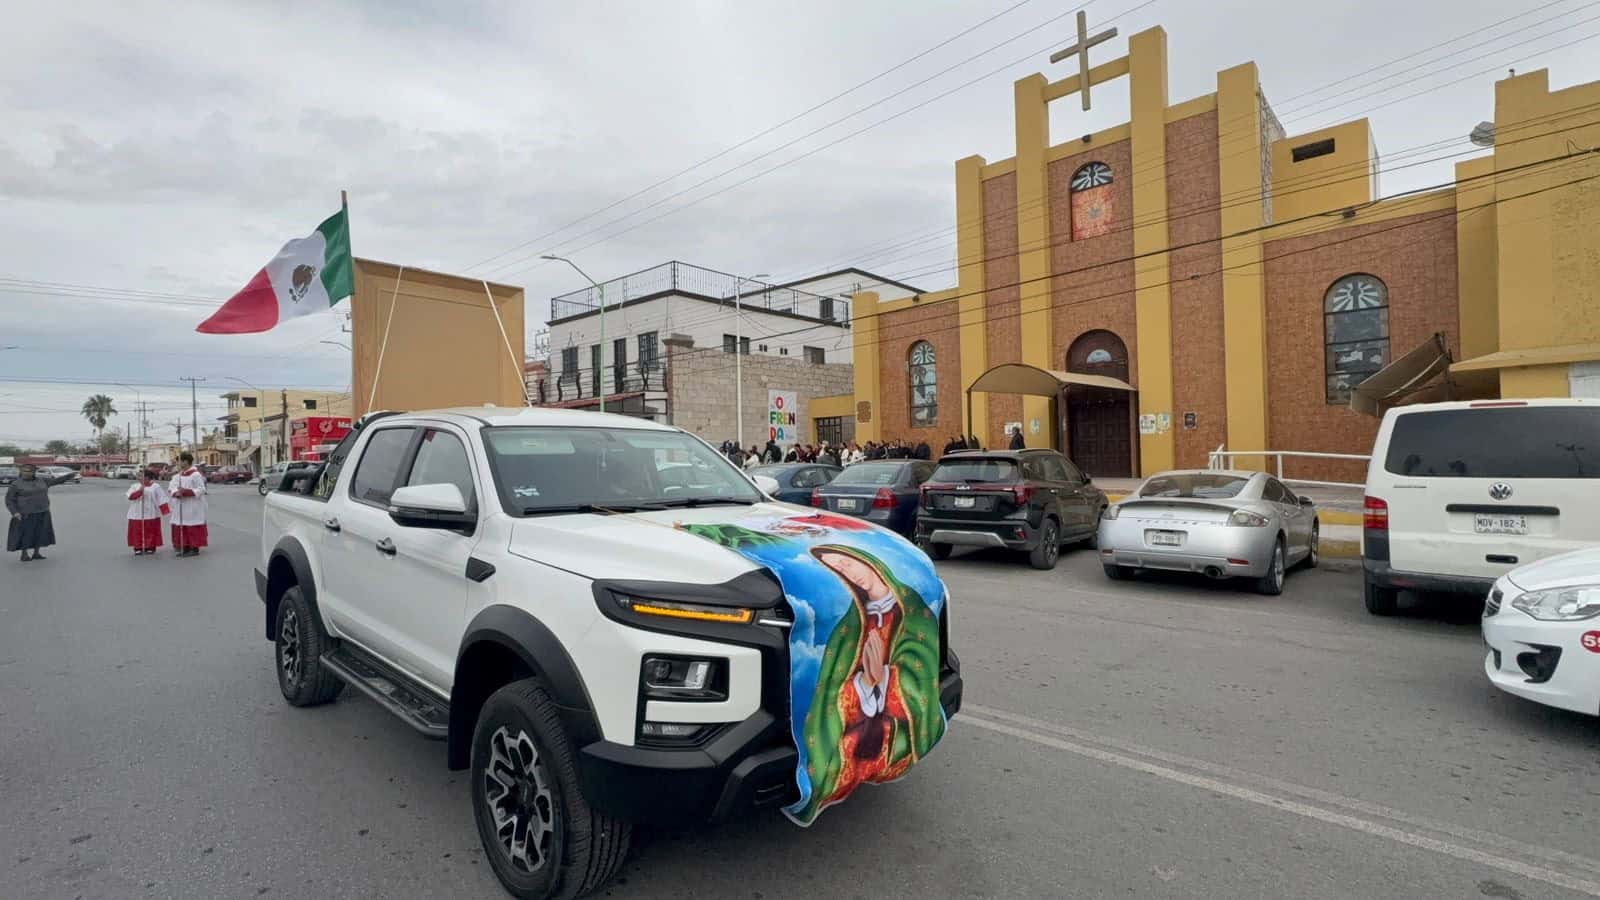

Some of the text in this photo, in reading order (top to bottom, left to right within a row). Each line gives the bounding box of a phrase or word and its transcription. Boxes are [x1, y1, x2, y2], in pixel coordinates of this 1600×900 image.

[775, 396, 784, 409] O
[770, 411, 795, 425] FREN
[770, 427, 784, 441] DA
[1583, 634, 1600, 648] 5
